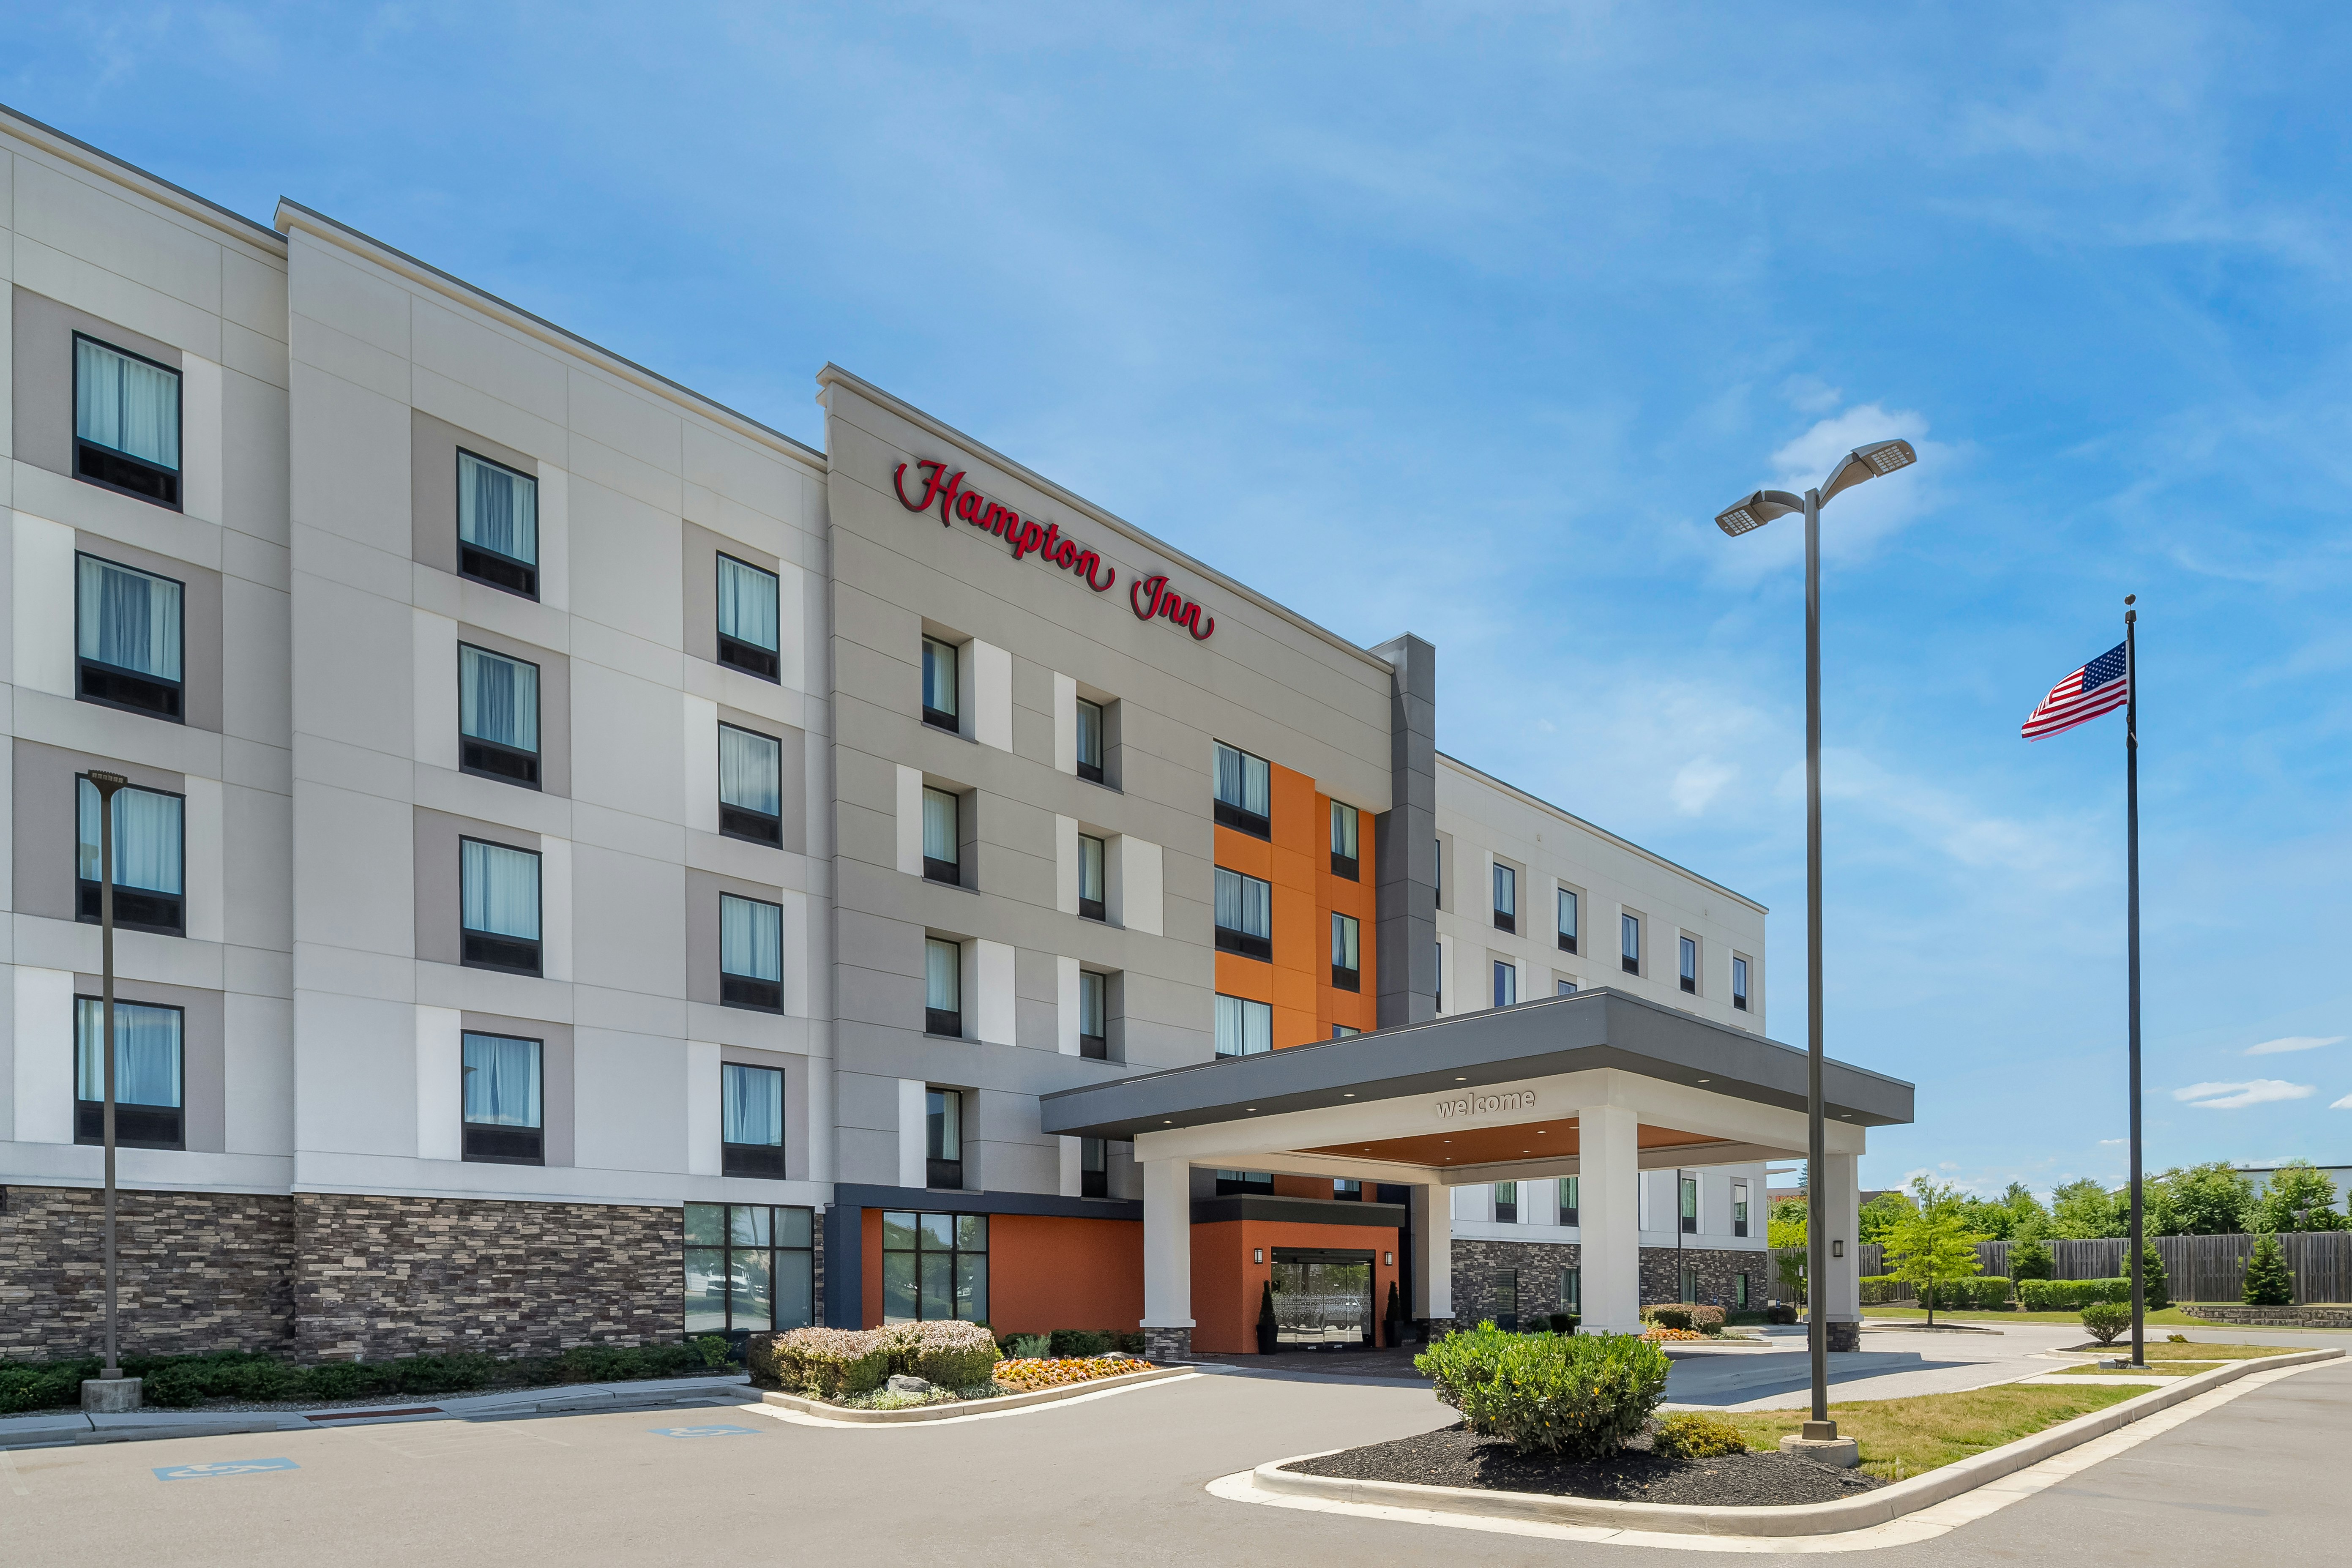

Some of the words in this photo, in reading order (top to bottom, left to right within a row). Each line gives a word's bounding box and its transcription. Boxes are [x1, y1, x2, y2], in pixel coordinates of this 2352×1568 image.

[893, 459, 1115, 592] Hampton
[1130, 575, 1215, 641] Inn
[1436, 1090, 1535, 1118] welcome
